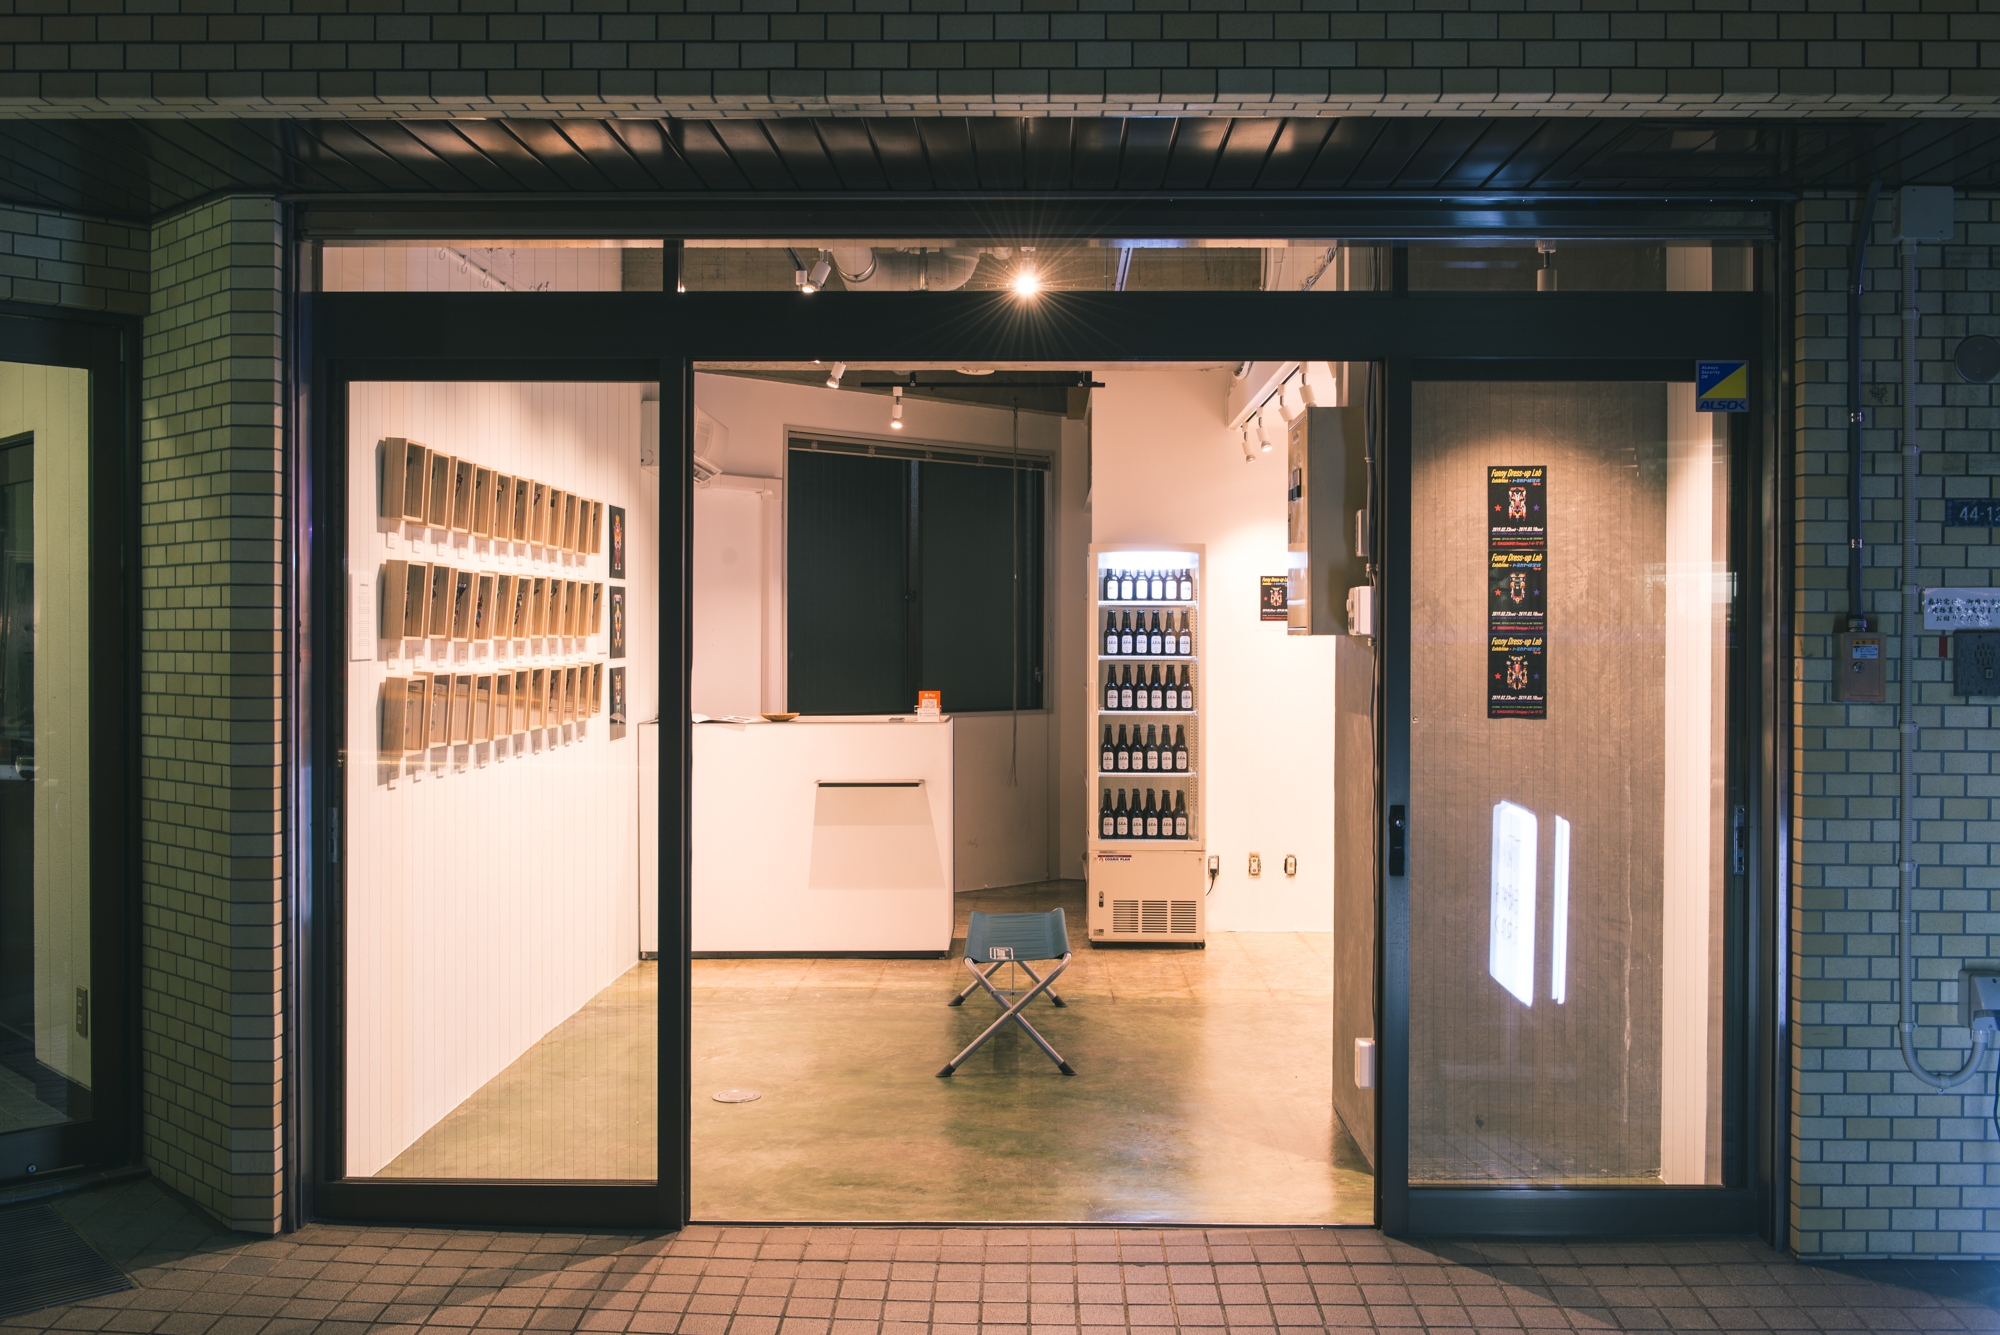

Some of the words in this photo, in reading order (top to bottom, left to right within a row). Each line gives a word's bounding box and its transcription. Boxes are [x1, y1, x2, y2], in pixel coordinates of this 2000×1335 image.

[1699, 400, 1746, 410] ALSOK
[1491, 469, 1507, 478] Funny
[1507, 469, 1532, 478] Dress-up
[1532, 469, 1542, 477] Lab
[1959, 506, 2000, 521] 44-12
[1492, 554, 1508, 563] Funny
[1508, 554, 1532, 563] Dress-up
[1532, 554, 1543, 562] Lab
[1492, 637, 1508, 647] Funny
[1508, 637, 1532, 647] Dress-up
[1532, 637, 1543, 645] Lab
